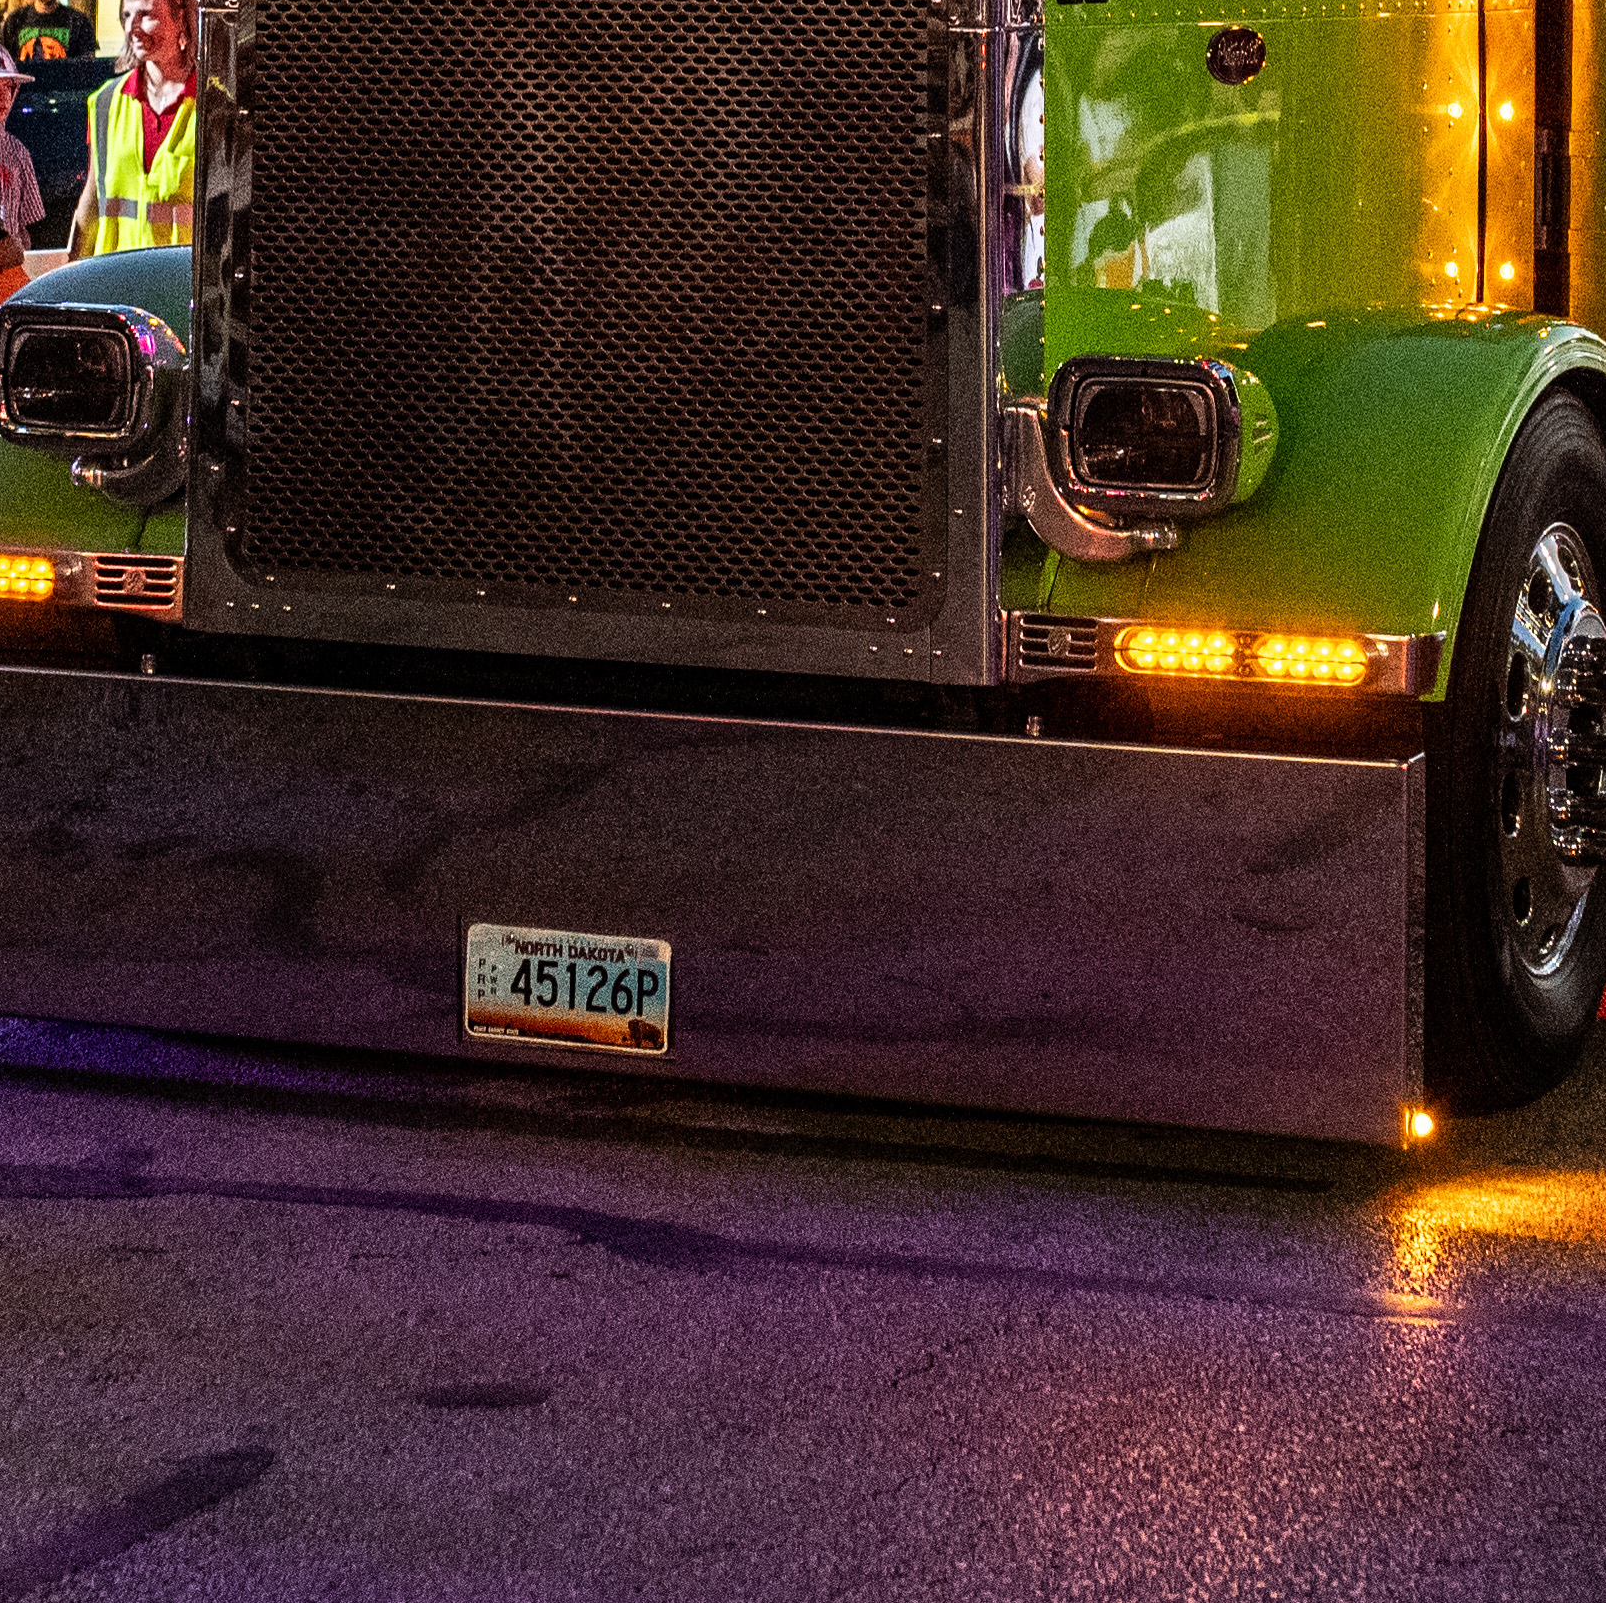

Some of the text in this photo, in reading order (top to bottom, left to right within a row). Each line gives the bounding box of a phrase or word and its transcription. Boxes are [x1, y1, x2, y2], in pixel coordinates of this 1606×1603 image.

[514, 940, 626, 963] NORTH DAKOTA
[510, 959, 659, 1017] 45126P
